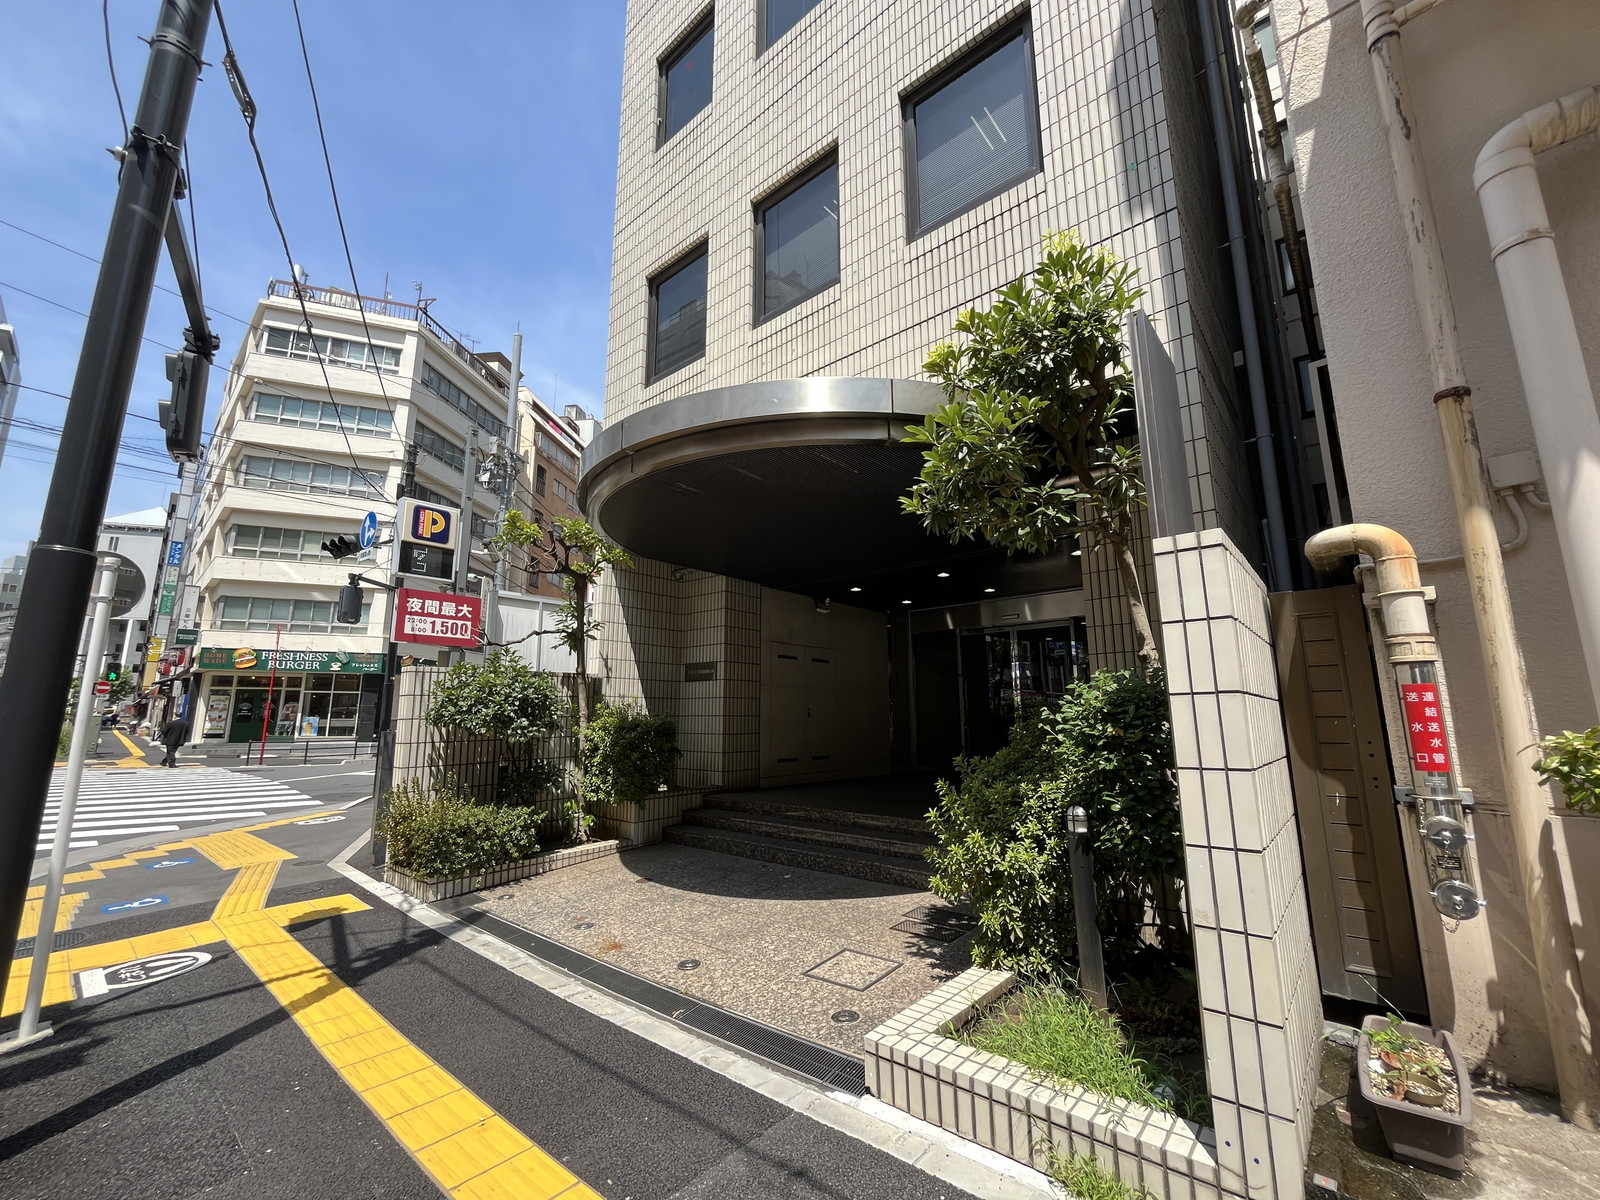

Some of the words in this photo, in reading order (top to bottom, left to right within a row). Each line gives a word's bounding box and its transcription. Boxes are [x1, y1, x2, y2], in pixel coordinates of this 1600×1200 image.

[406, 597, 473, 618] 夜間最大
[406, 617, 428, 625] 22:00
[261, 651, 328, 661] FRESHNESS
[267, 661, 320, 670] BURGER
[1405, 691, 1430, 764] 送水口
[1421, 691, 1446, 764] 連結送水管
